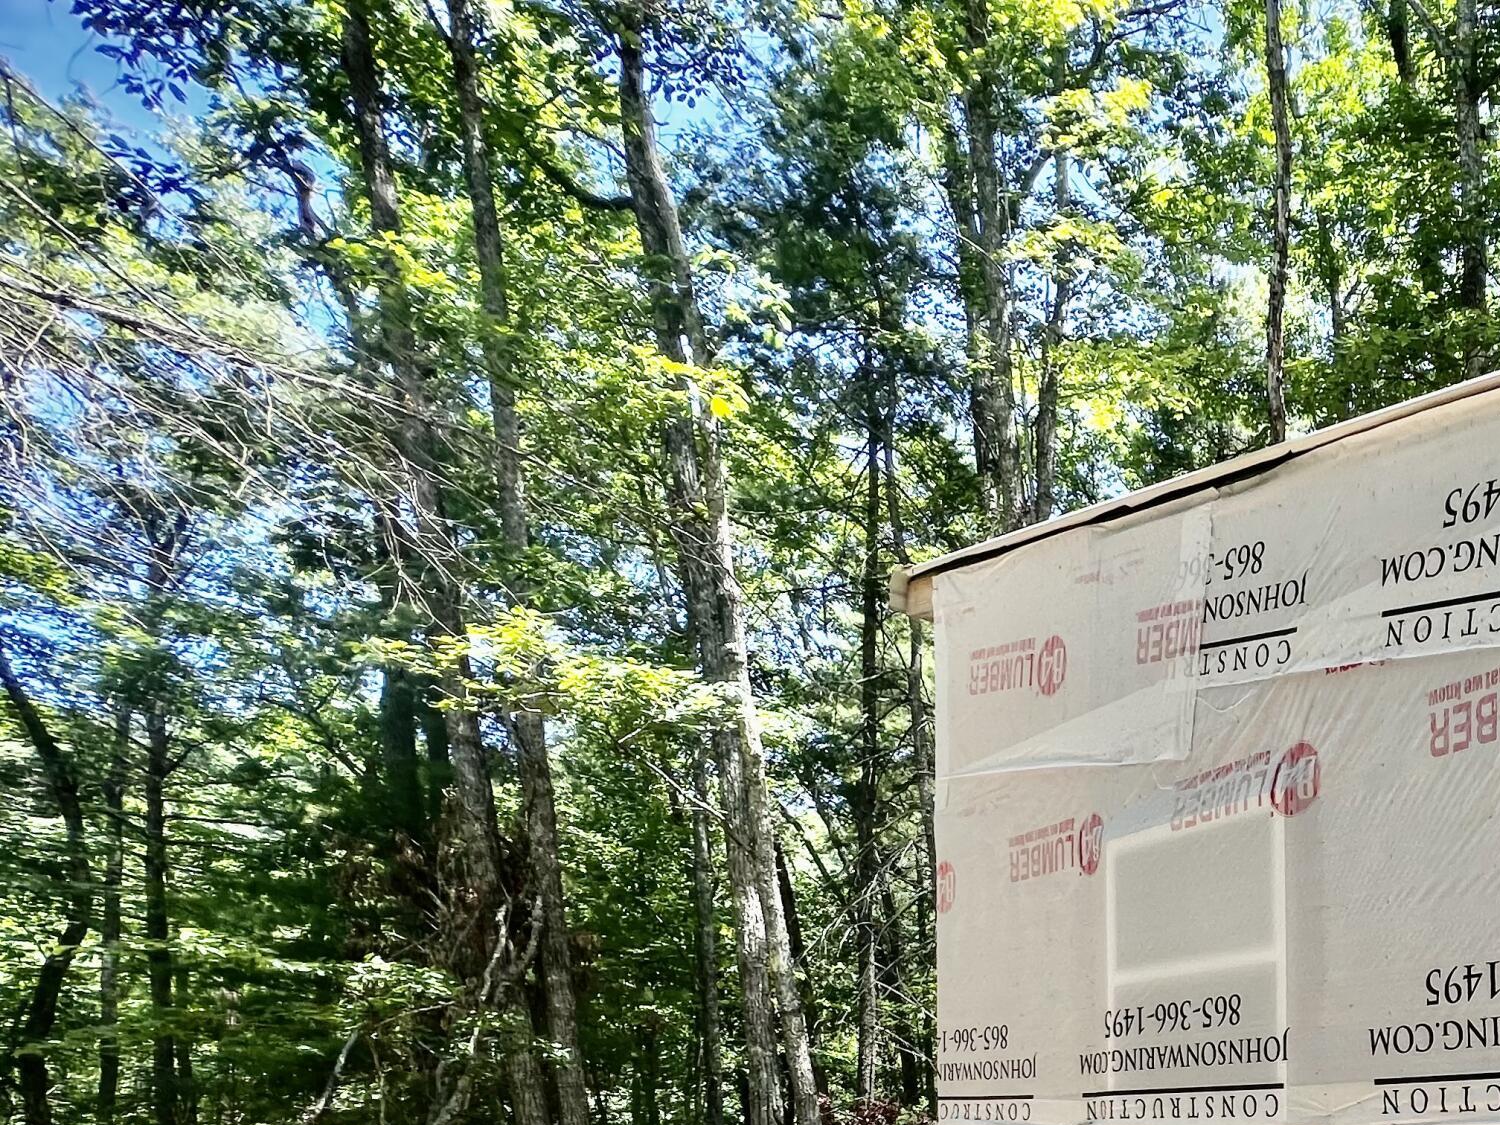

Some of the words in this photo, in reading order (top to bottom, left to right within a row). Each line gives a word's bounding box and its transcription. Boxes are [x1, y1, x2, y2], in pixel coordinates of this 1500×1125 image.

[968, 654, 1035, 696] LUMBER
[1009, 834, 1074, 883] LUMBER
[1104, 993, 1241, 1039] 865-366-1495
[938, 1025, 1009, 1053] 865-366-1
[1079, 1027, 1291, 1075] JOHNSONWARING.COM
[1085, 1093, 1279, 1121] CONSTRUCTION
